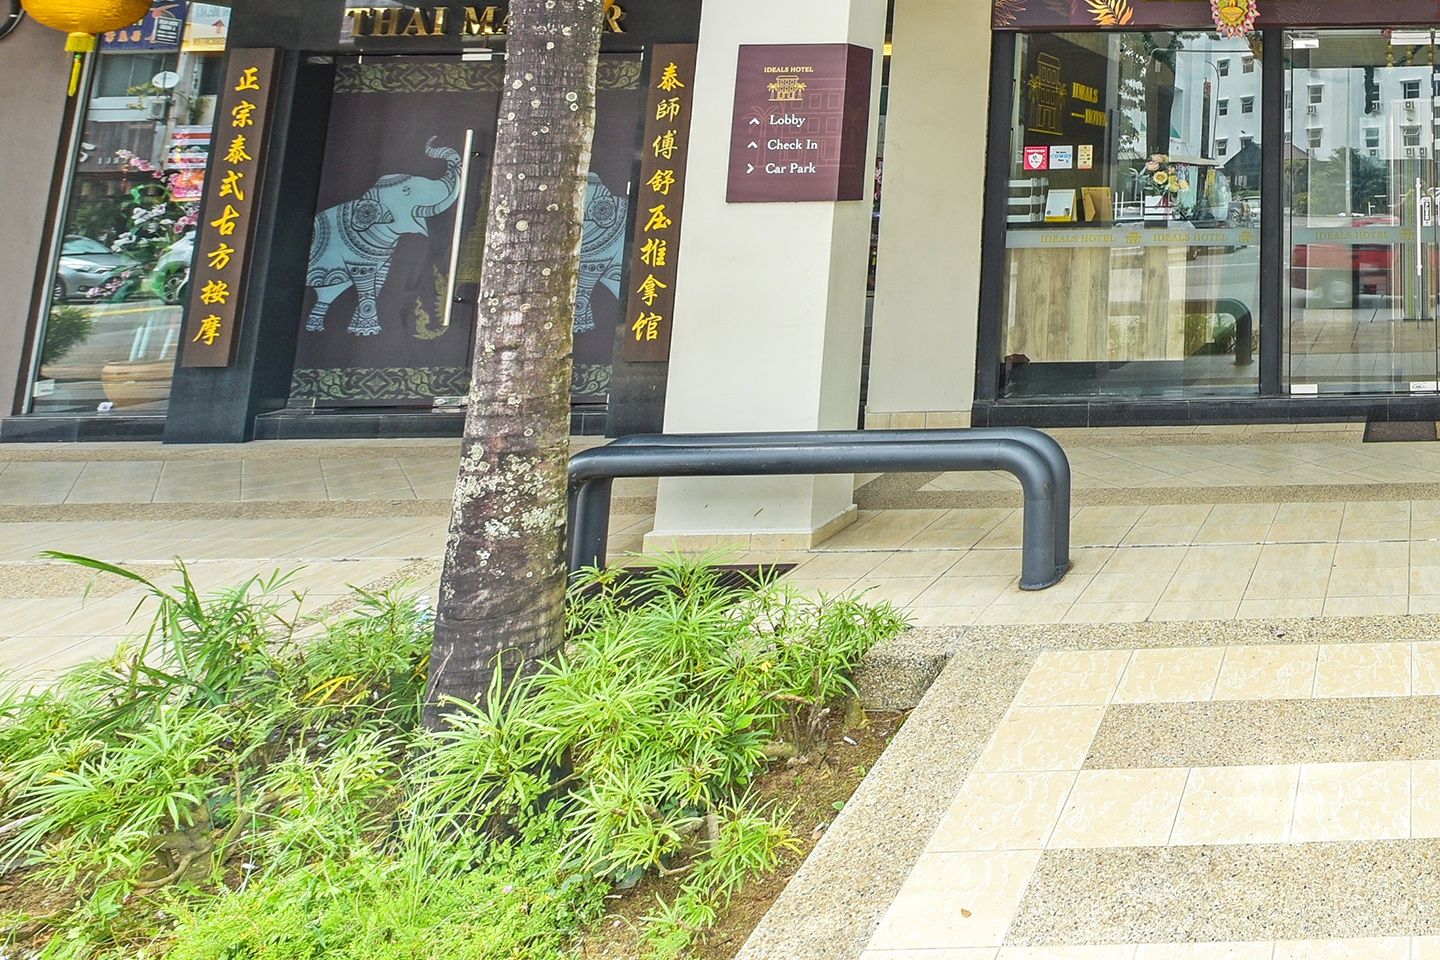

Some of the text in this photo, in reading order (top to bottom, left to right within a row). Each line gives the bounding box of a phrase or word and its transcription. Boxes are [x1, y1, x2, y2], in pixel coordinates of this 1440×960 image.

[344, 7, 448, 36] THAI
[769, 114, 806, 128] Lobby
[767, 139, 818, 151] Check In
[765, 161, 817, 175] Car Park
[192, 66, 261, 346] 正宗泰式古方按摩
[1040, 235, 1116, 243] IDEALS HOTEL
[1153, 233, 1228, 242] IDEALS HOTEL
[1315, 231, 1390, 240] IDEALS HOTEL
